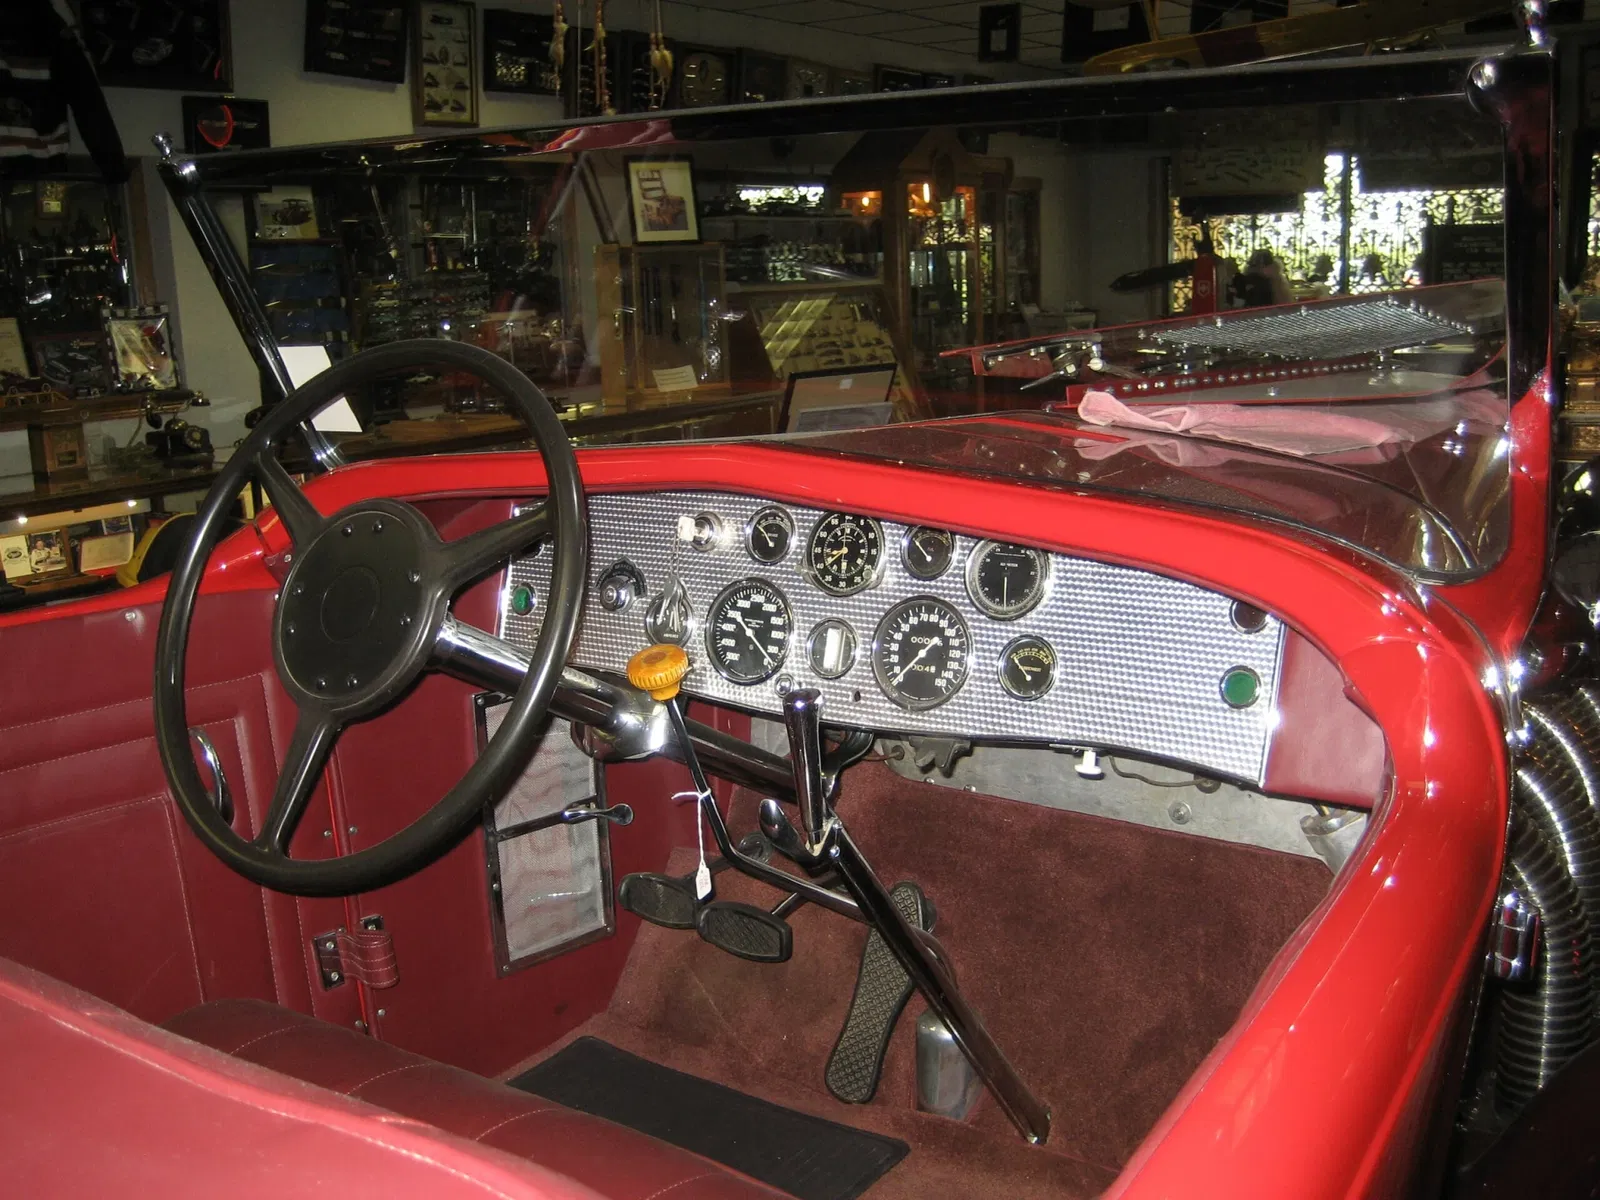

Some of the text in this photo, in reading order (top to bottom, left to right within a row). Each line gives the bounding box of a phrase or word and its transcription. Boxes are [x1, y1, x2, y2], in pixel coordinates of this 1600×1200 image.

[920, 614, 928, 622] 70
[901, 624, 910, 632] 50
[944, 629, 956, 637] 100
[949, 638, 959, 646] 110
[767, 645, 779, 653] 500
[890, 643, 899, 651] 30
[949, 650, 960, 658] 120
[890, 655, 899, 663] 20
[894, 666, 900, 674] 10
[935, 678, 946, 686] 150
